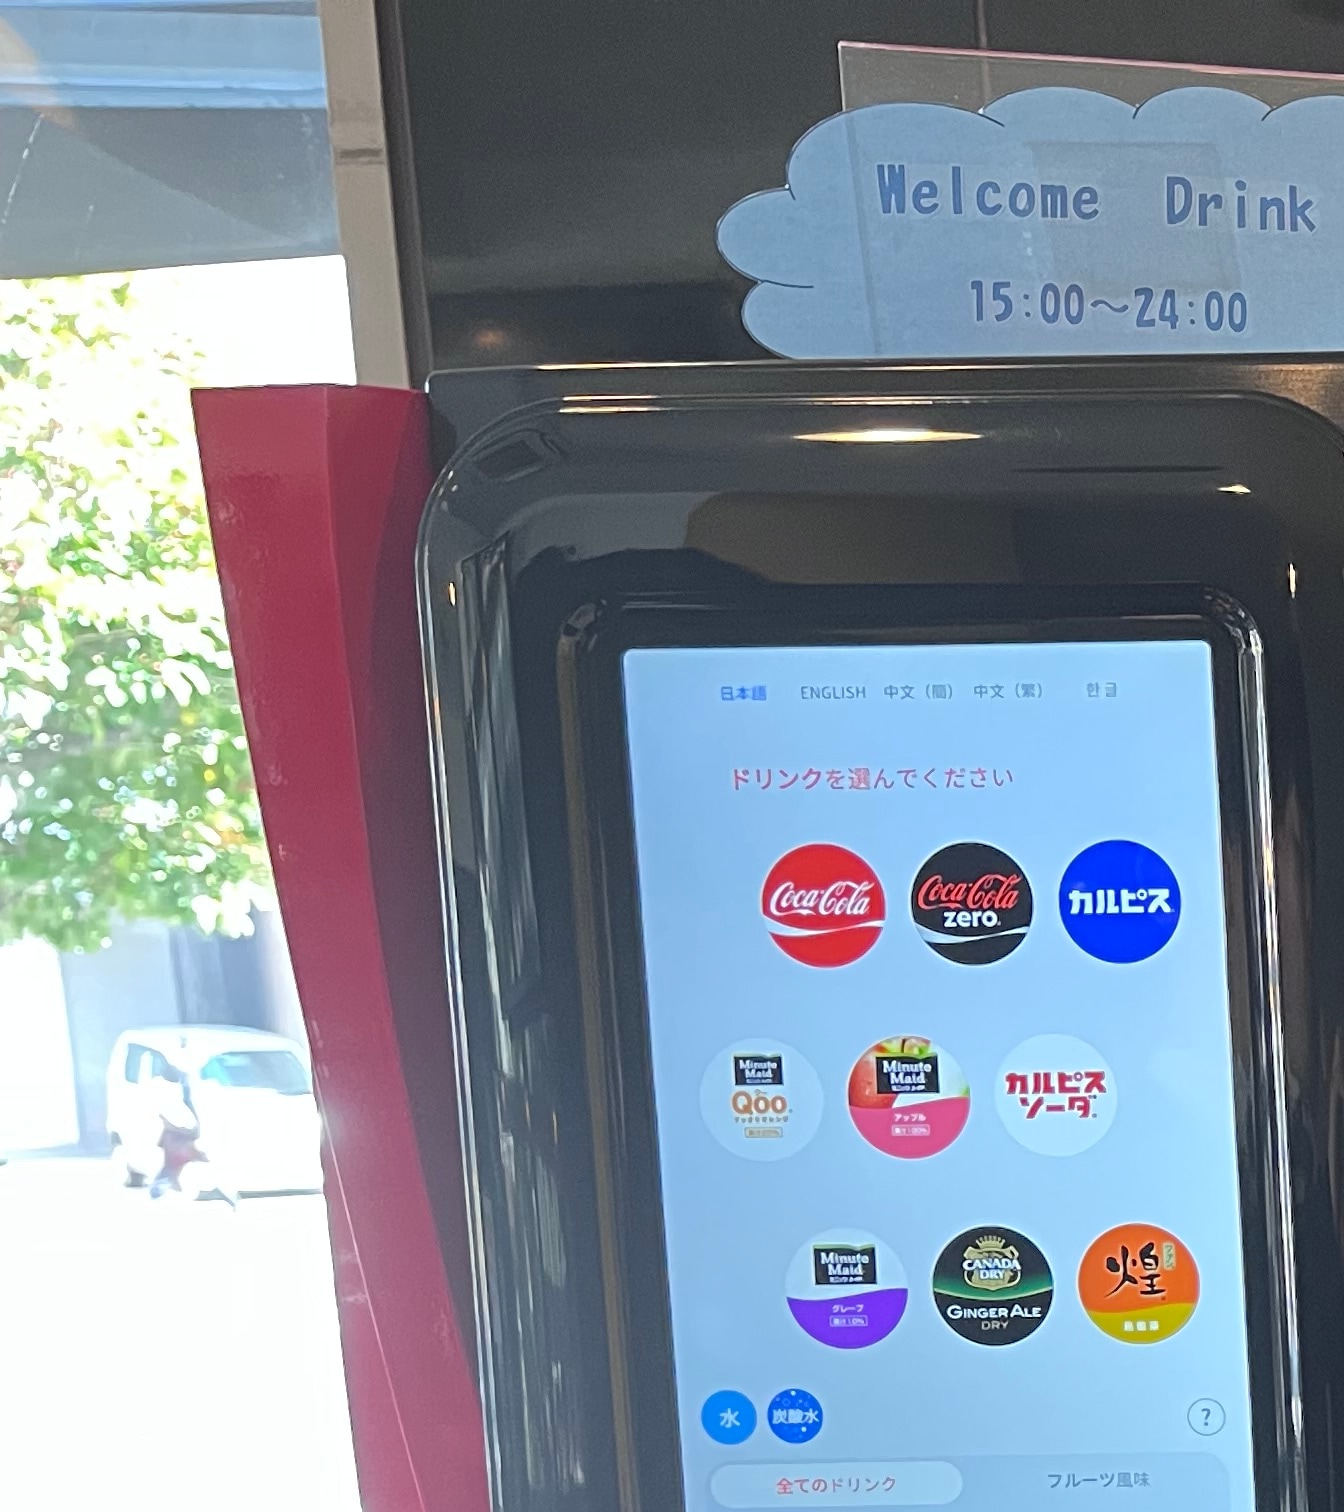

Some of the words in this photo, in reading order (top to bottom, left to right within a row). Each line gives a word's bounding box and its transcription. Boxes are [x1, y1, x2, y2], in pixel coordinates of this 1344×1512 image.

[876, 163, 1101, 222] Welcome
[1166, 175, 1317, 234] Drink
[720, 685, 767, 701] 日本語
[800, 684, 866, 700] ENGLISH
[731, 766, 1014, 791] ドリンクを選んでください
[770, 880, 875, 917] Coca-Cola
[917, 873, 1023, 911] Coca-Cola
[1068, 887, 1171, 915] カルピス
[882, 1059, 932, 1073] Minute
[889, 1071, 926, 1085] Maid
[1005, 1071, 1107, 1095] カルピス
[731, 1089, 788, 1115] Qoo
[1018, 1094, 1098, 1120] ソーダ
[820, 1251, 870, 1265] Minute
[962, 1258, 1021, 1271] CANADA
[828, 1263, 864, 1276] Maid
[980, 1269, 1005, 1280] DRY
[947, 1304, 1009, 1319] GINGER
[1010, 1303, 1042, 1318] ALE
[981, 1320, 1009, 1331] DRY
[719, 1407, 741, 1429] 水
[775, 1475, 897, 1496] 全てのドリンク
[1046, 1470, 1151, 1490] フルーツ風味
